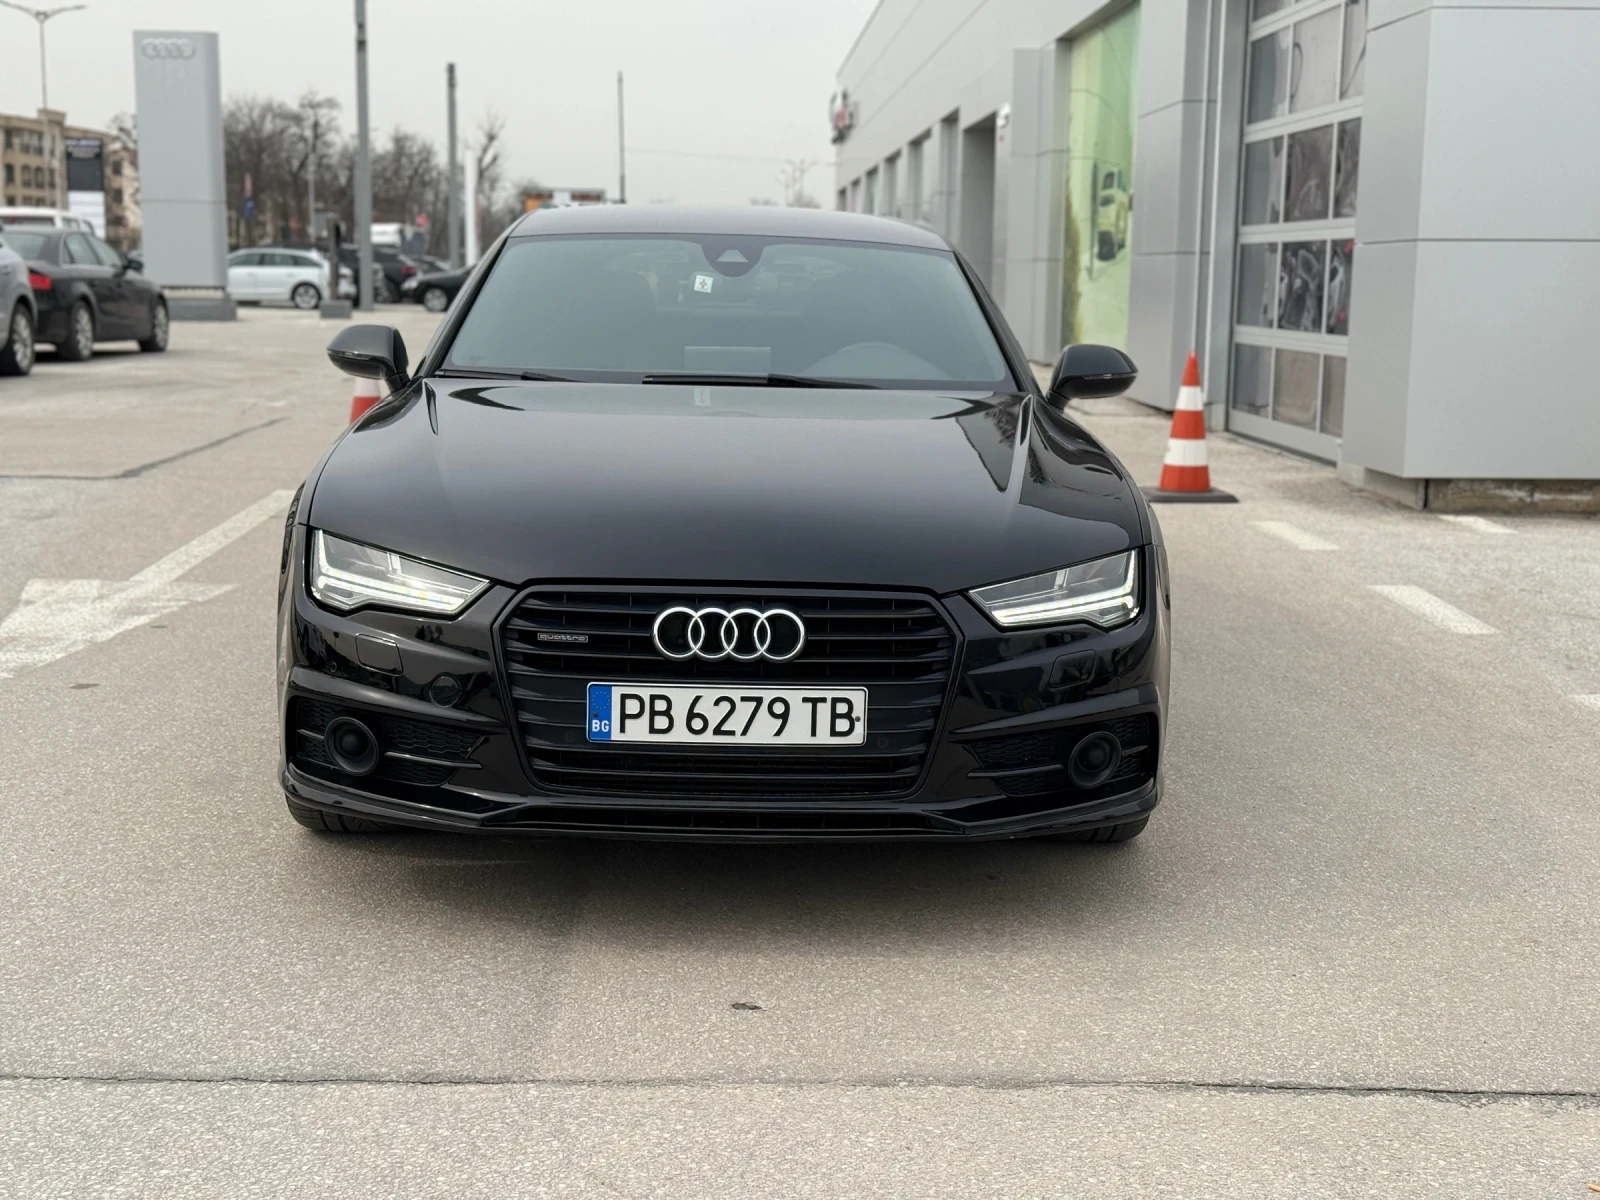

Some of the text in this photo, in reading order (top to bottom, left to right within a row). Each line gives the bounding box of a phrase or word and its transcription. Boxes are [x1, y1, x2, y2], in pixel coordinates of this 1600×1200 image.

[592, 719, 610, 733] BG
[619, 693, 856, 737] PB 6279 TB
